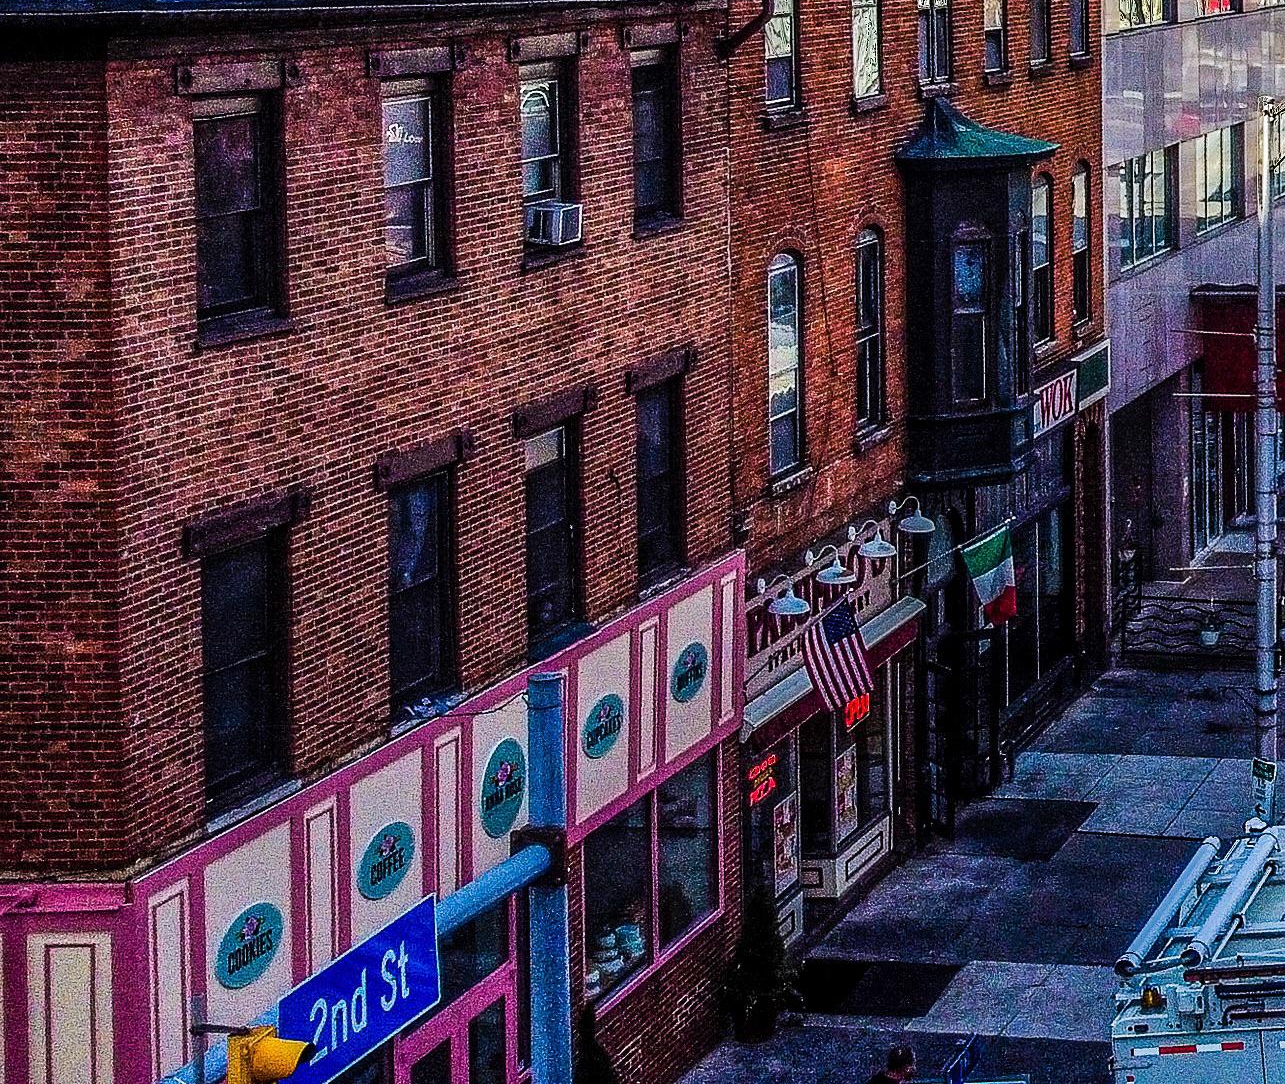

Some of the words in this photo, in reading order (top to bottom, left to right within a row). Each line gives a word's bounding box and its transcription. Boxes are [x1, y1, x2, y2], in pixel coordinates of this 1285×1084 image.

[1040, 375, 1074, 428] WOK
[370, 847, 405, 886] COFFEE
[227, 929, 273, 976] COOKIES
[309, 968, 367, 1066] 2nd
[381, 941, 409, 1011] St
